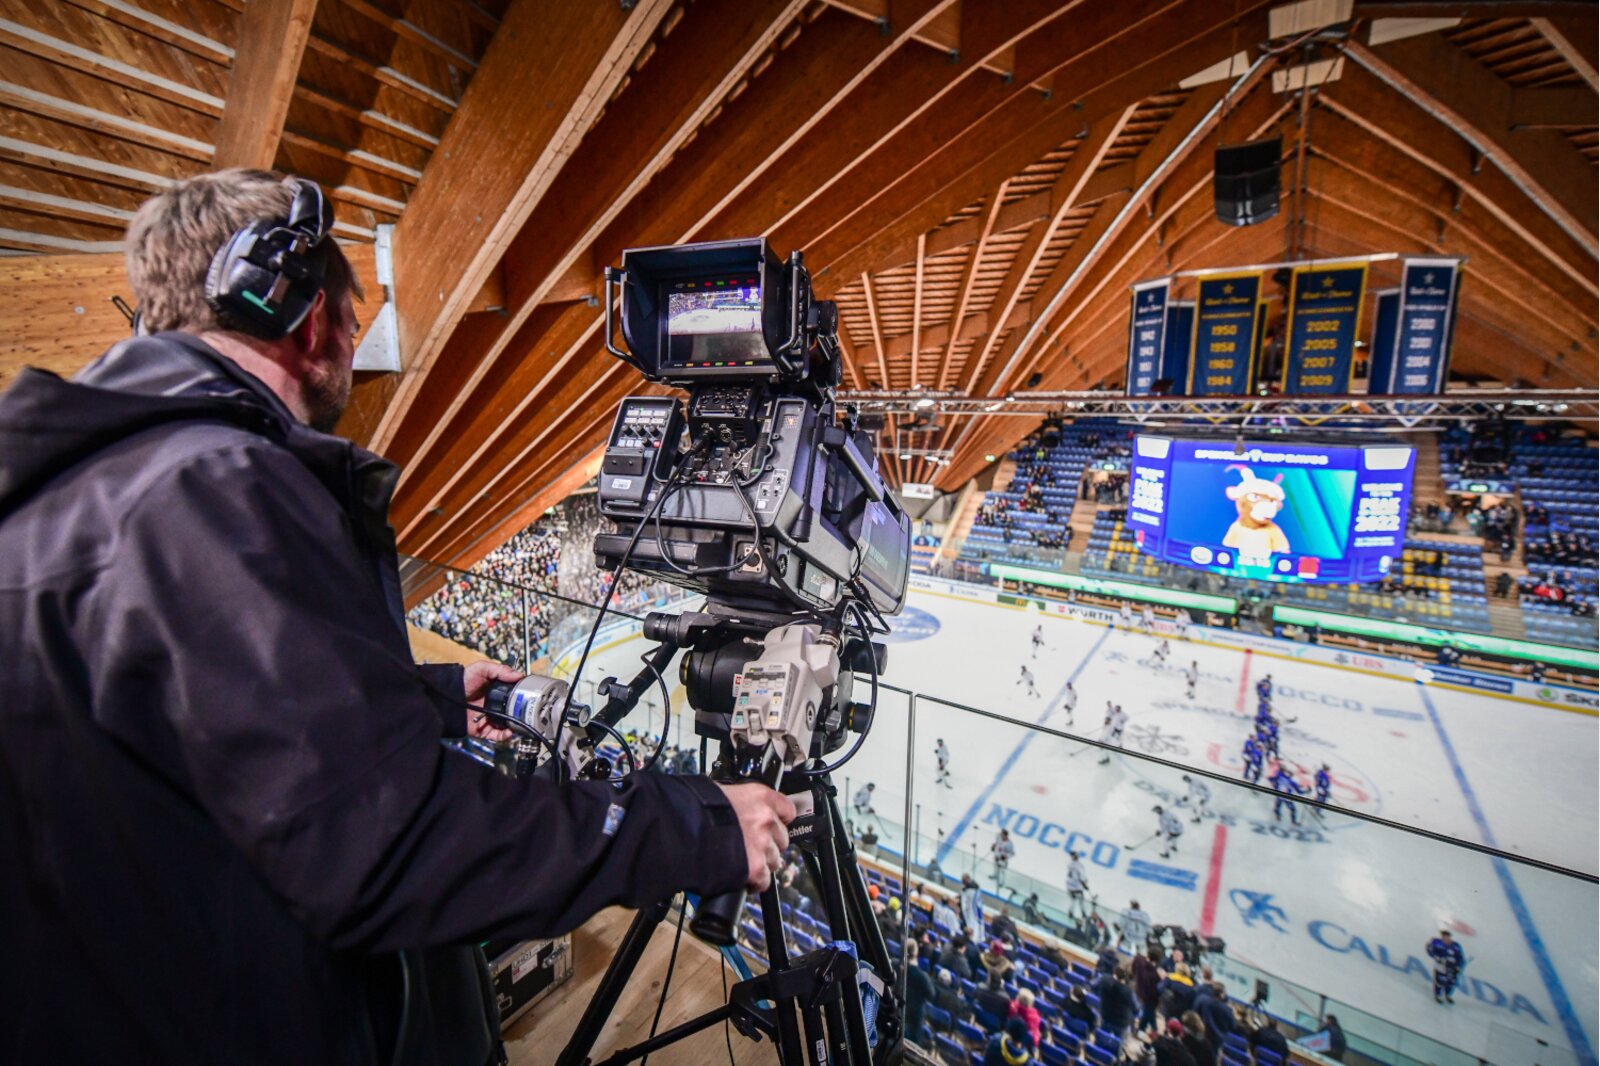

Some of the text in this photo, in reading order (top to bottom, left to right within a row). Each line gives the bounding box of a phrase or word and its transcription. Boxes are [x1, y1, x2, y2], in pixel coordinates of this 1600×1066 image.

[1306, 320, 1340, 333] 2002
[1304, 338, 1338, 350] 2005
[1302, 357, 1335, 368] 2007
[1352, 656, 1384, 670] UBS
[1273, 685, 1364, 713] OCCO
[788, 824, 814, 838] chtler
[982, 803, 1121, 869] NOCCO
